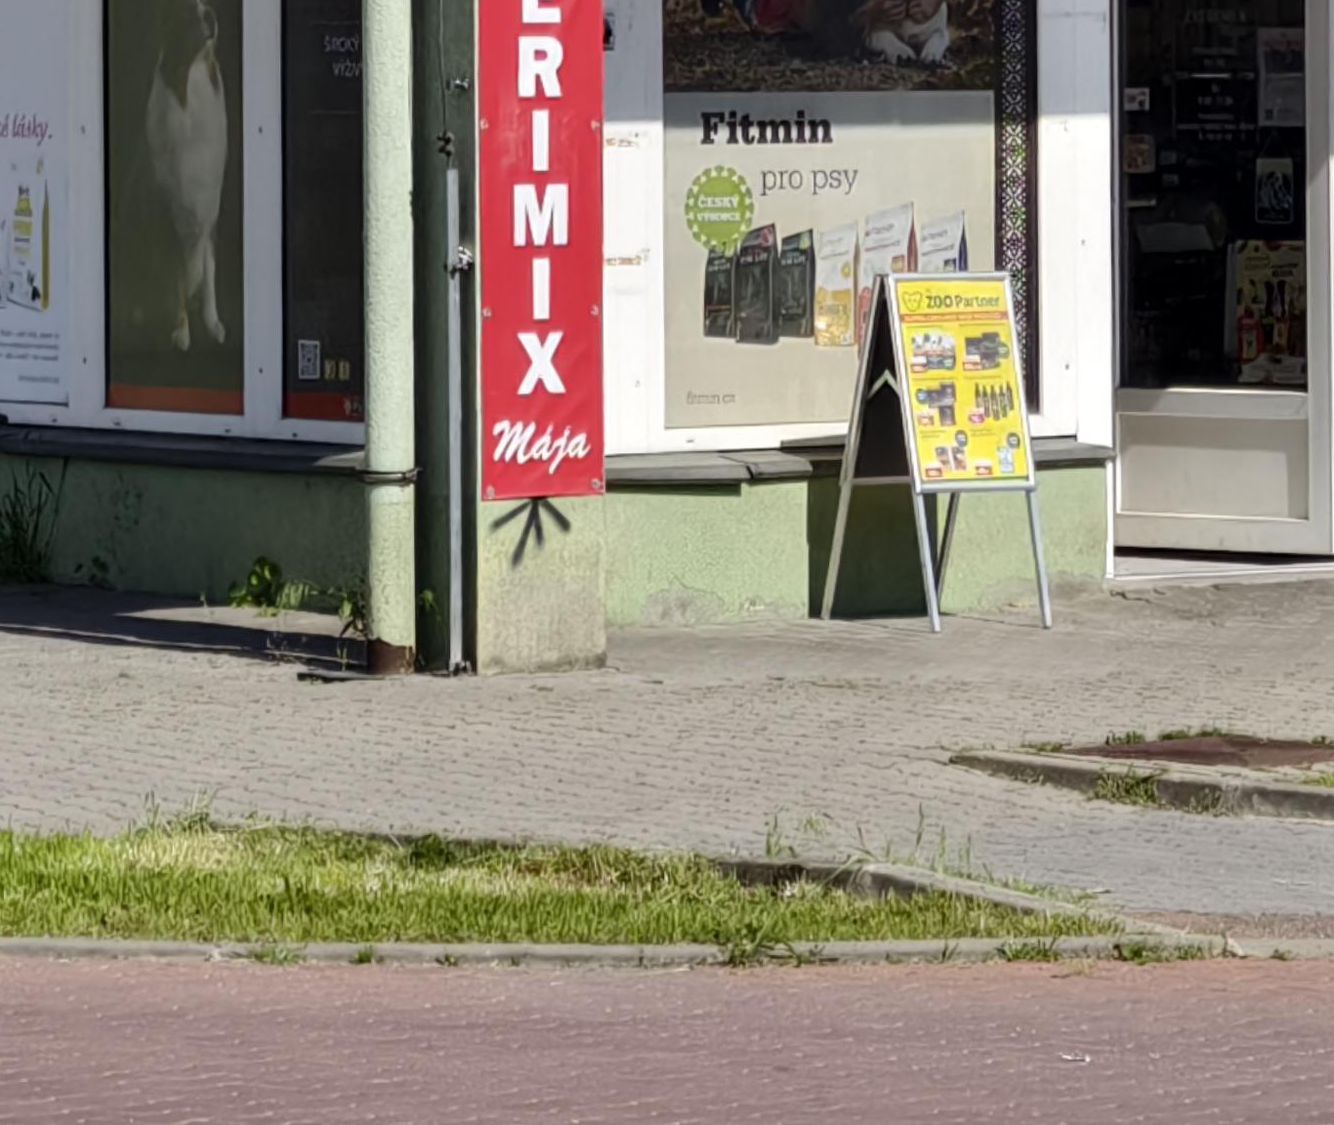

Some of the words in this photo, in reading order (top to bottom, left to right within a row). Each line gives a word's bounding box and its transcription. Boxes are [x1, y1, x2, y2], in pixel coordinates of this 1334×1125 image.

[701, 110, 833, 145] Fitmin
[760, 169, 803, 196] pro
[812, 169, 859, 195] psy
[697, 193, 739, 209] ČESKÝ
[926, 293, 953, 309] ZOO
[954, 294, 1000, 308] Partner
[492, 419, 591, 465] Mája
